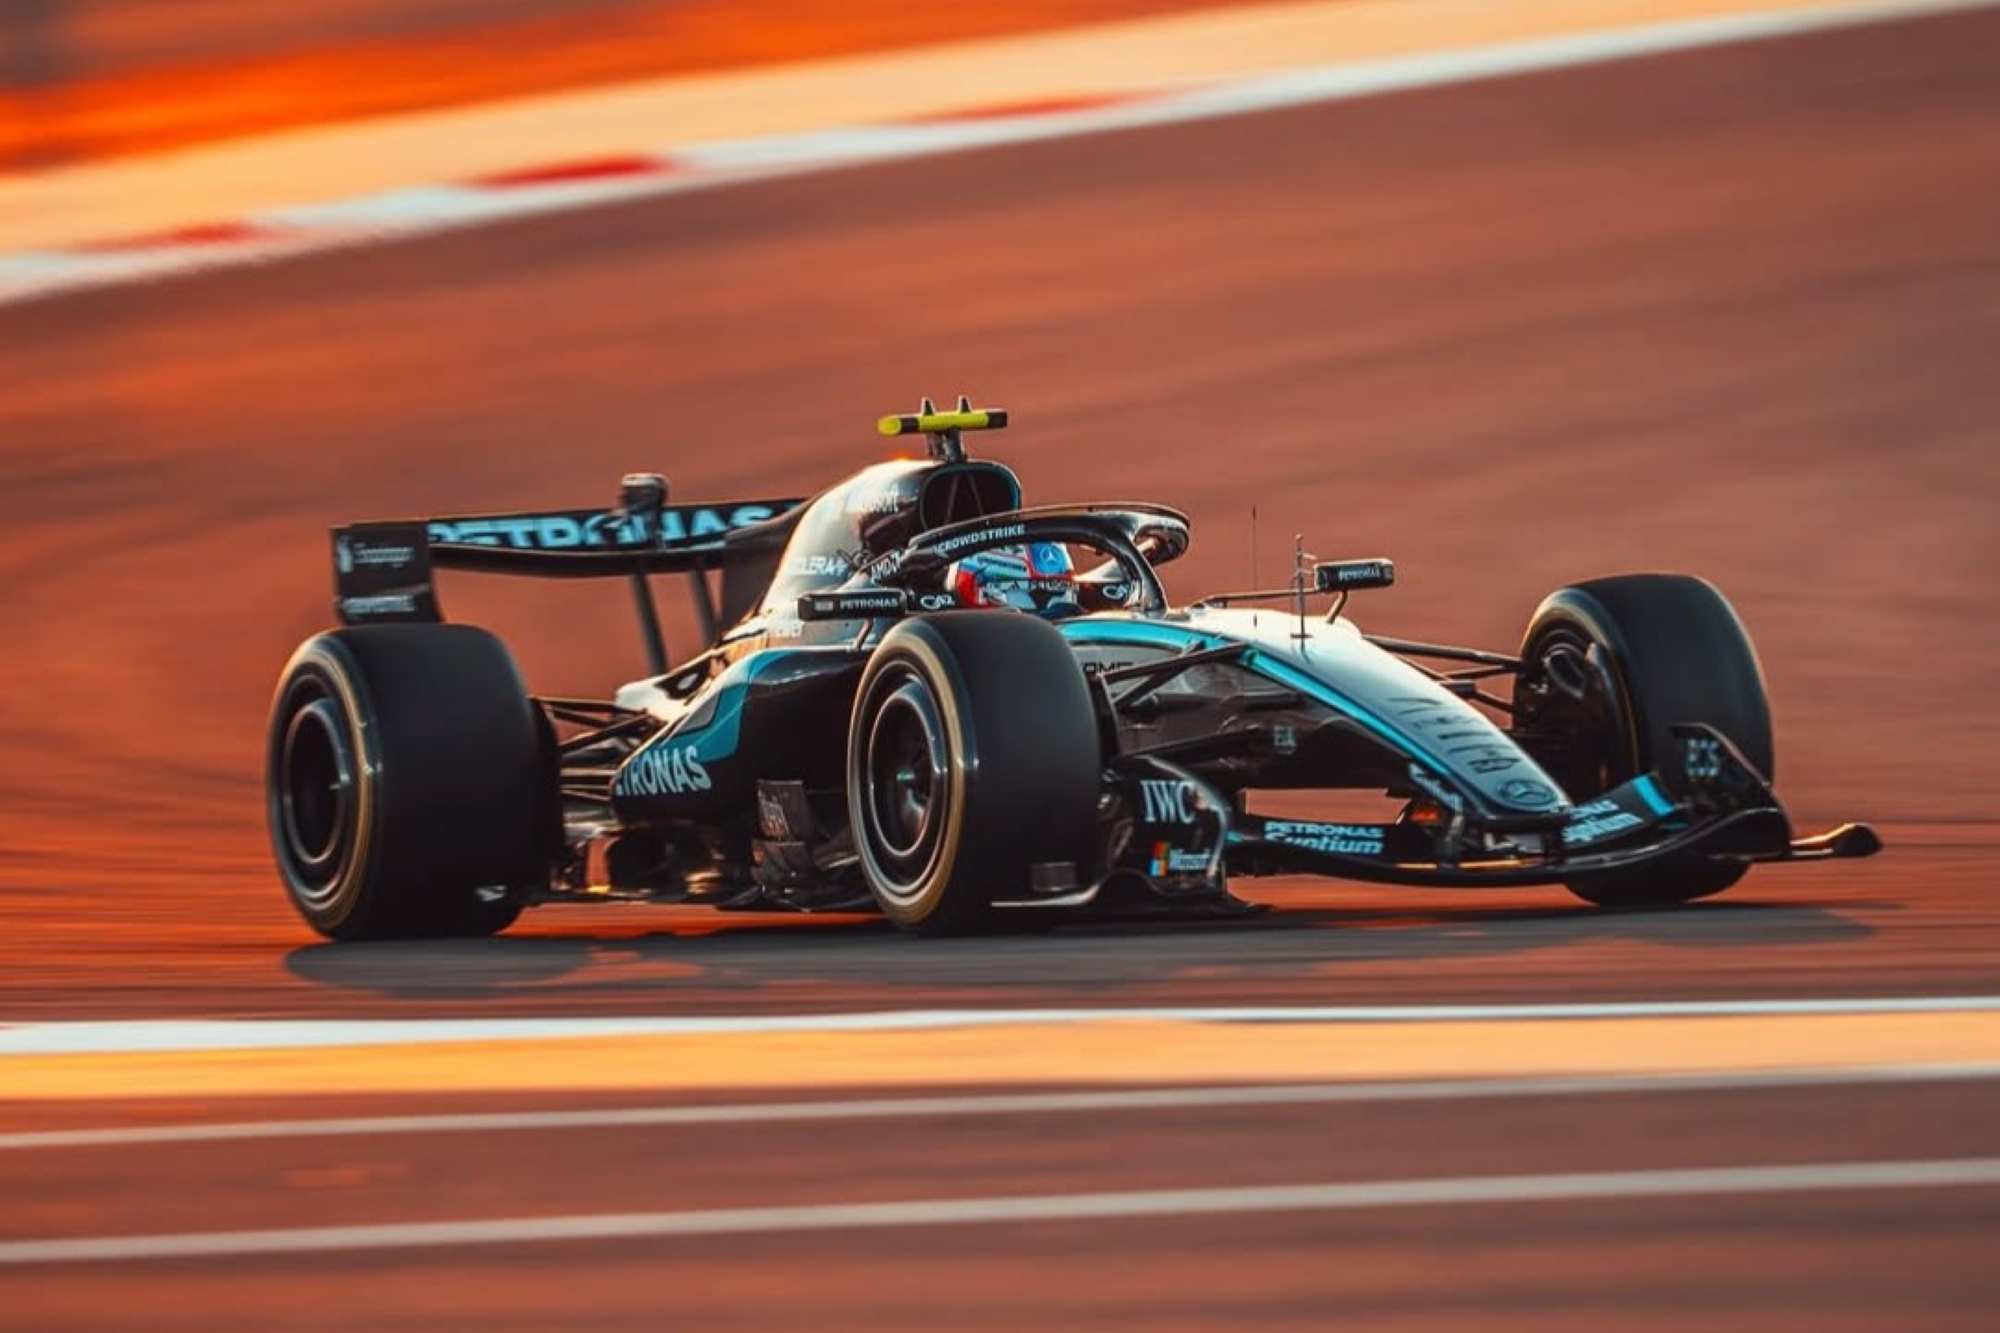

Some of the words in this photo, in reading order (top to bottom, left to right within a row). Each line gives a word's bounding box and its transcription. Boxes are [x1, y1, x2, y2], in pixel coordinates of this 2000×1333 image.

[939, 524, 1026, 551] CROWDSTRIKE
[839, 598, 899, 610] PETRONAS
[1140, 780, 1196, 824] IWC
[1264, 821, 1384, 839] PETRONAS
